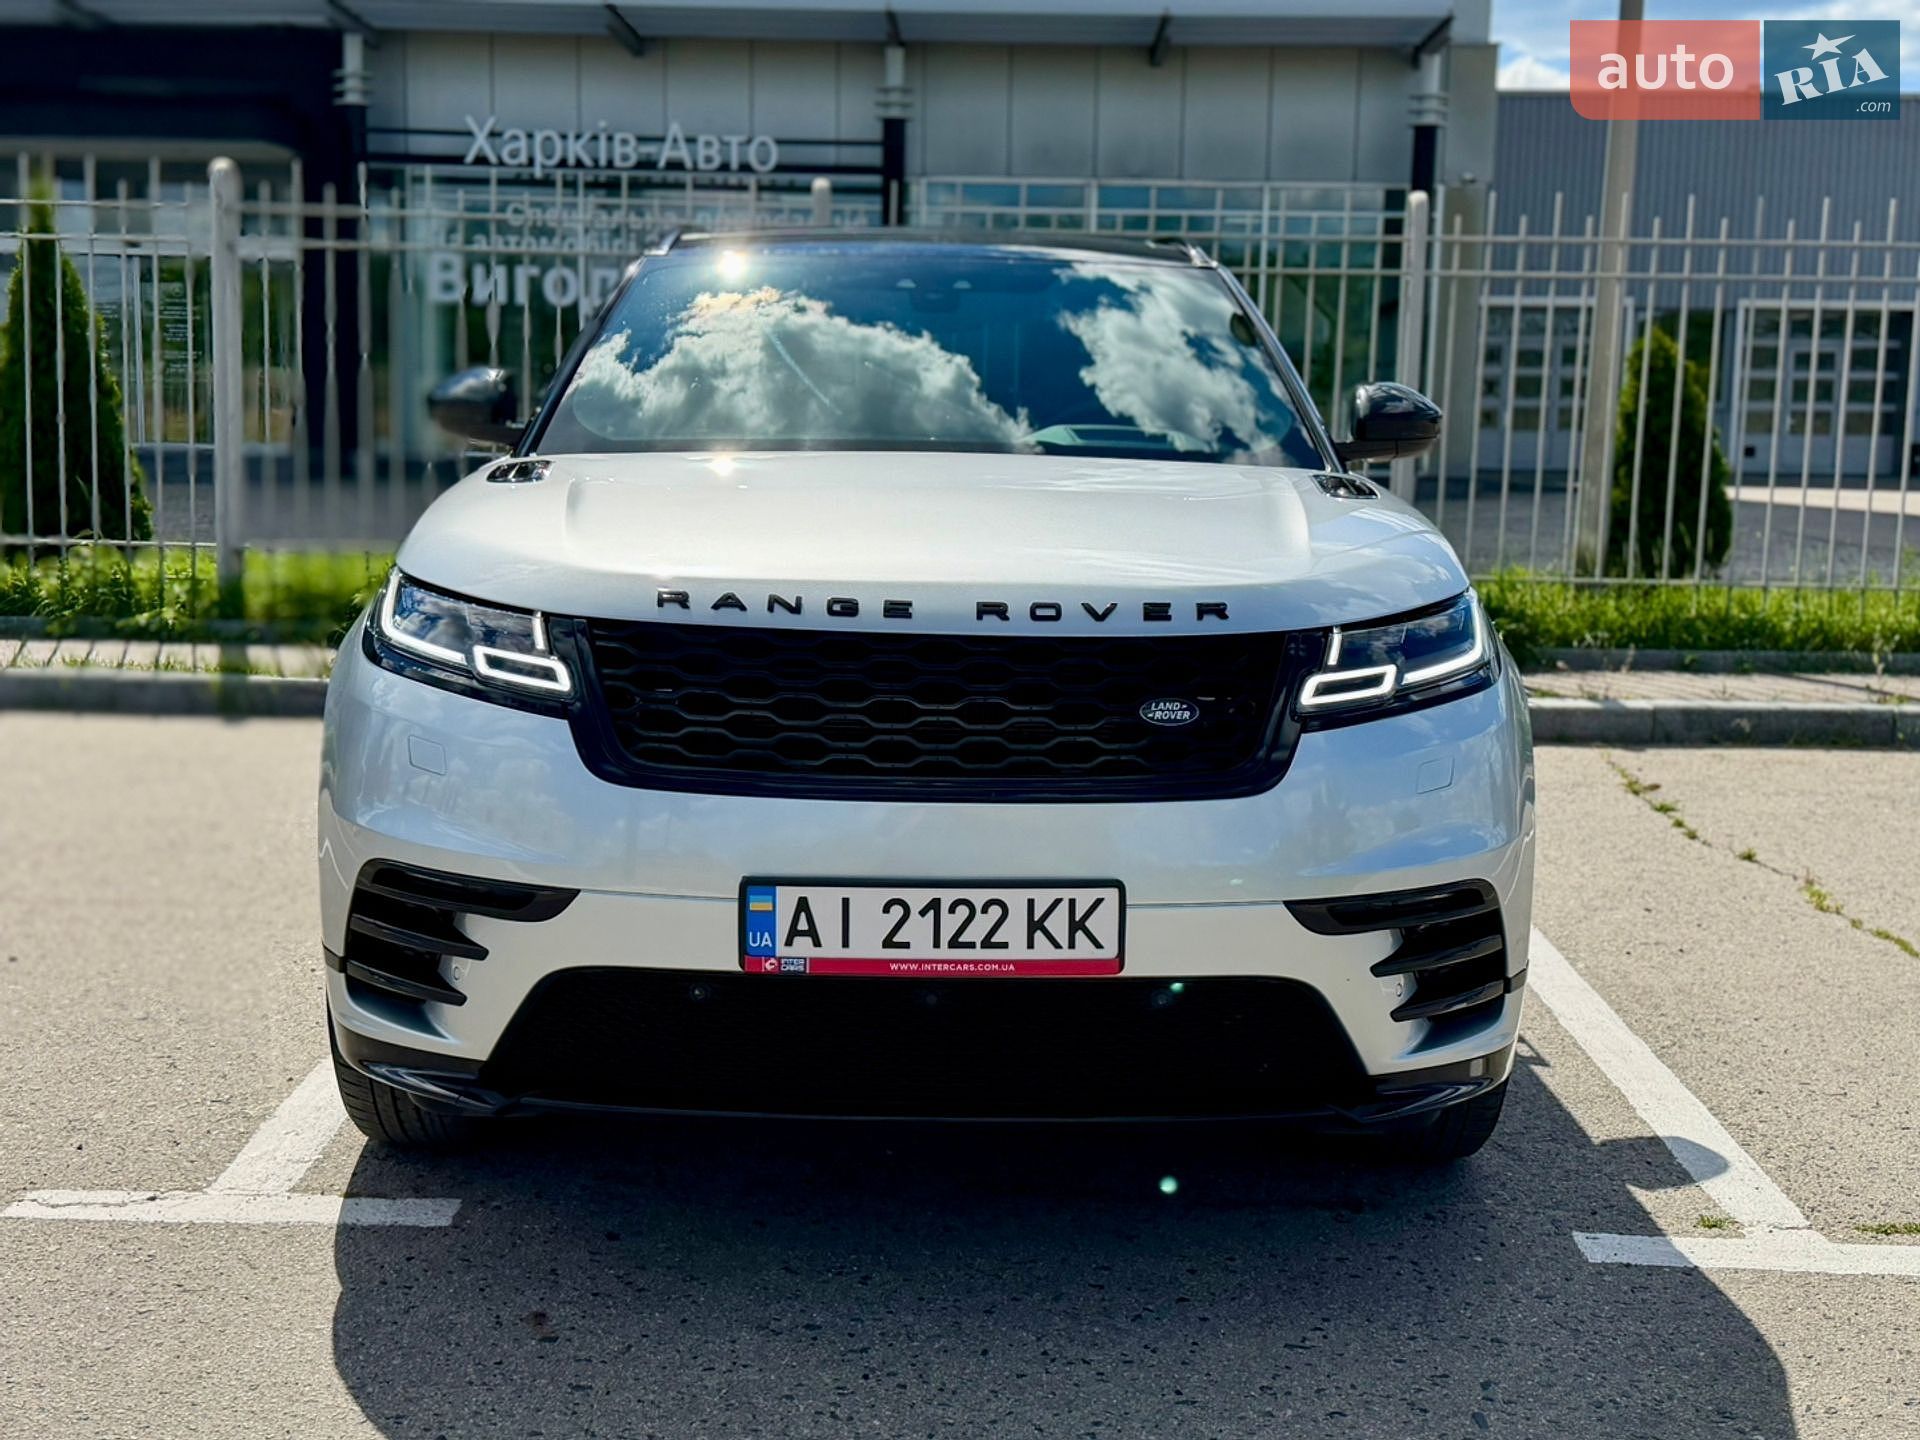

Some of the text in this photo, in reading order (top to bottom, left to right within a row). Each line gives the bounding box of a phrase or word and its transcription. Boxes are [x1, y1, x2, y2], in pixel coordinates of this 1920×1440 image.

[463, 114, 780, 177] Харків-Авто
[657, 590, 1231, 622] RANGE ROVER
[1151, 702, 1180, 711] LAND
[1154, 710, 1191, 720] ROVER
[784, 896, 1105, 950] AI 2122 KK
[749, 931, 773, 948] UA
[889, 962, 1015, 973] WWW.INTERCARS.COM.UA
